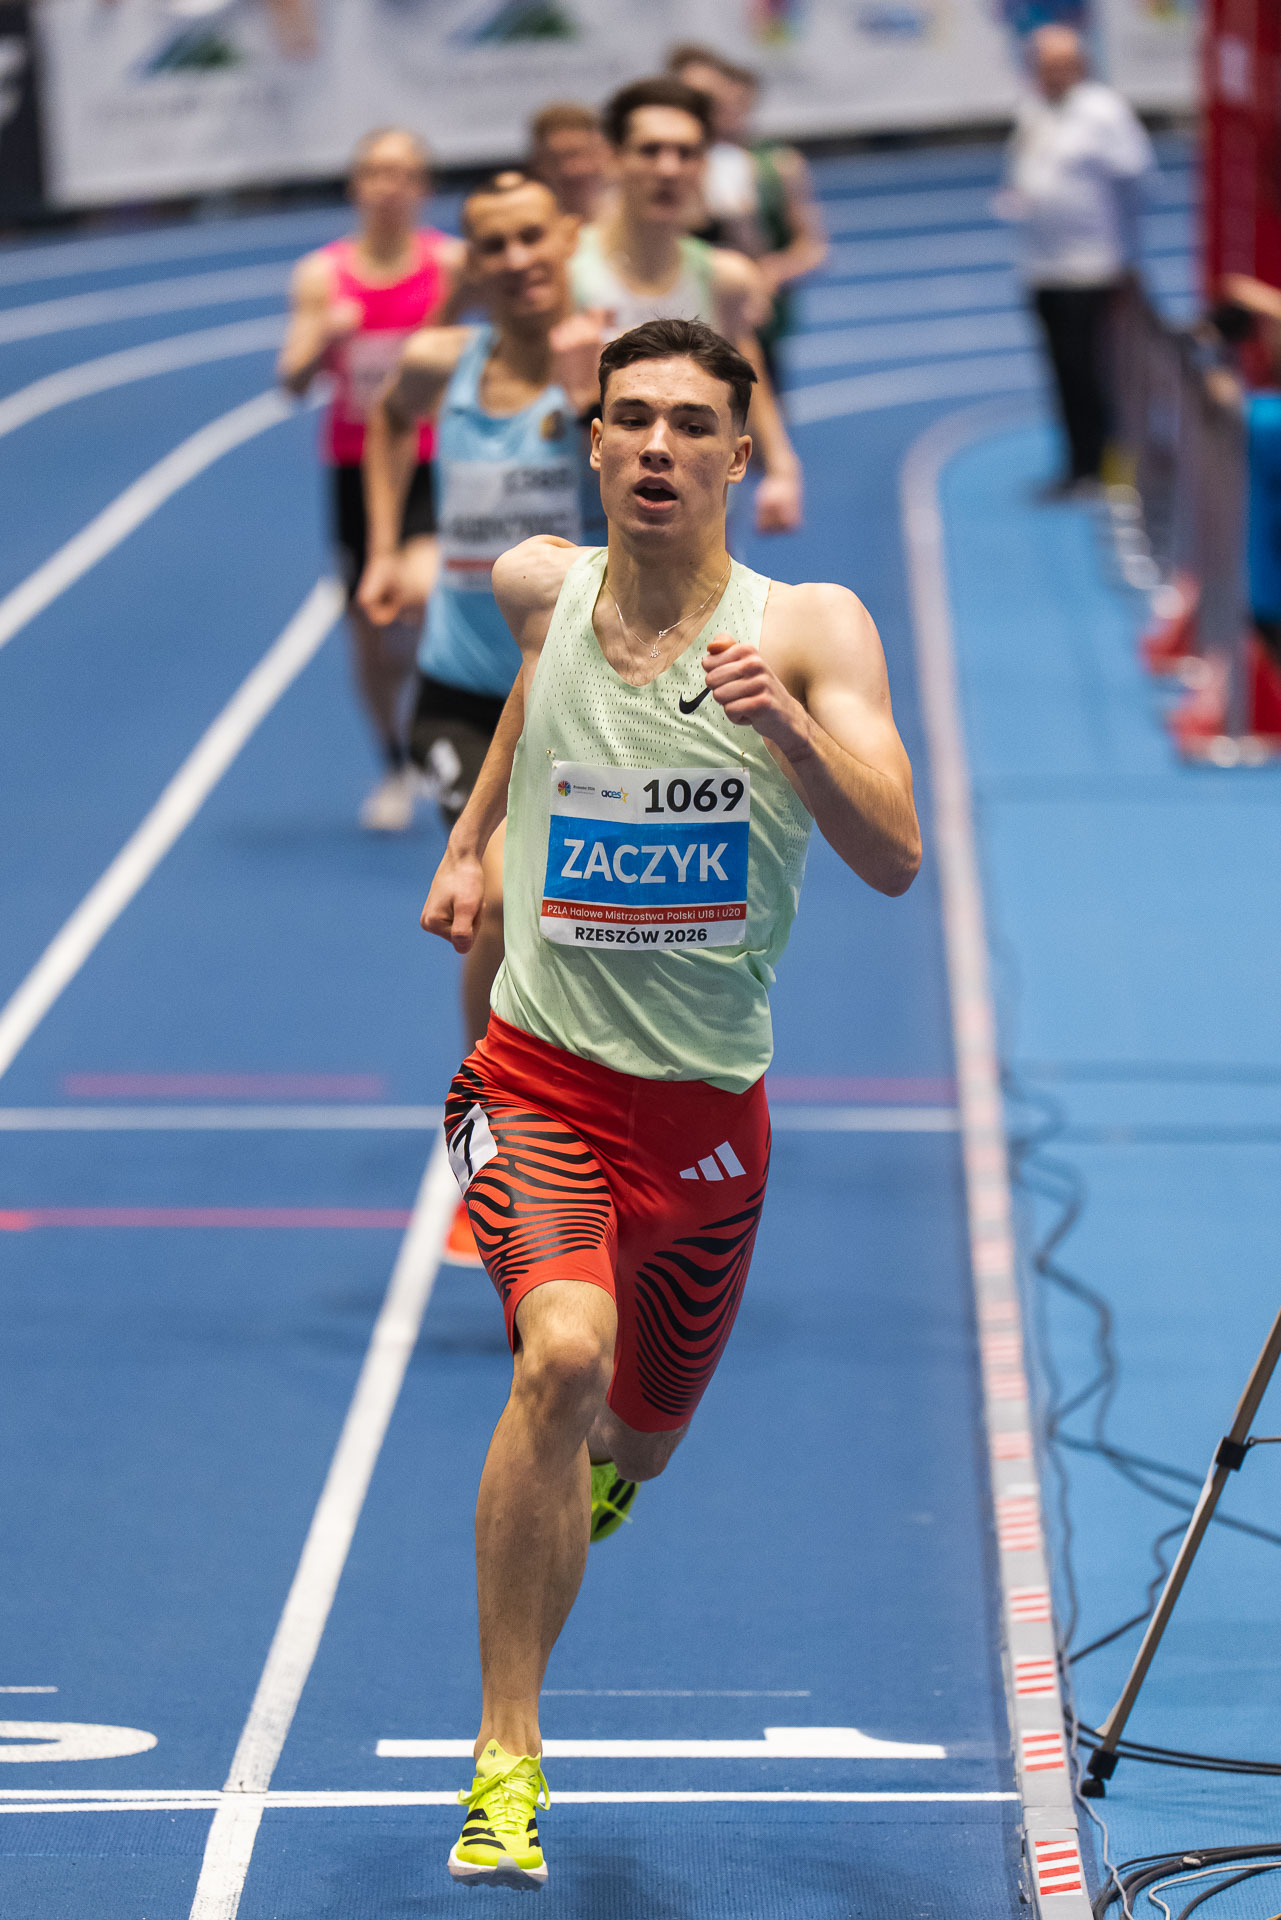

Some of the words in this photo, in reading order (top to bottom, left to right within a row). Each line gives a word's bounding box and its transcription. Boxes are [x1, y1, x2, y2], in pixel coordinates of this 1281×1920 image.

[601, 789, 622, 799] aces
[643, 778, 745, 813] 1069
[561, 838, 729, 884] ZACZYK
[547, 904, 568, 914] PZLA
[570, 907, 603, 919] Halowe
[605, 911, 664, 921] Mistrzostwa
[667, 910, 696, 920] Polski
[698, 909, 715, 919] U18
[722, 907, 741, 917] U20
[575, 926, 659, 944] RZESZÓW
[664, 928, 708, 943] 2026
